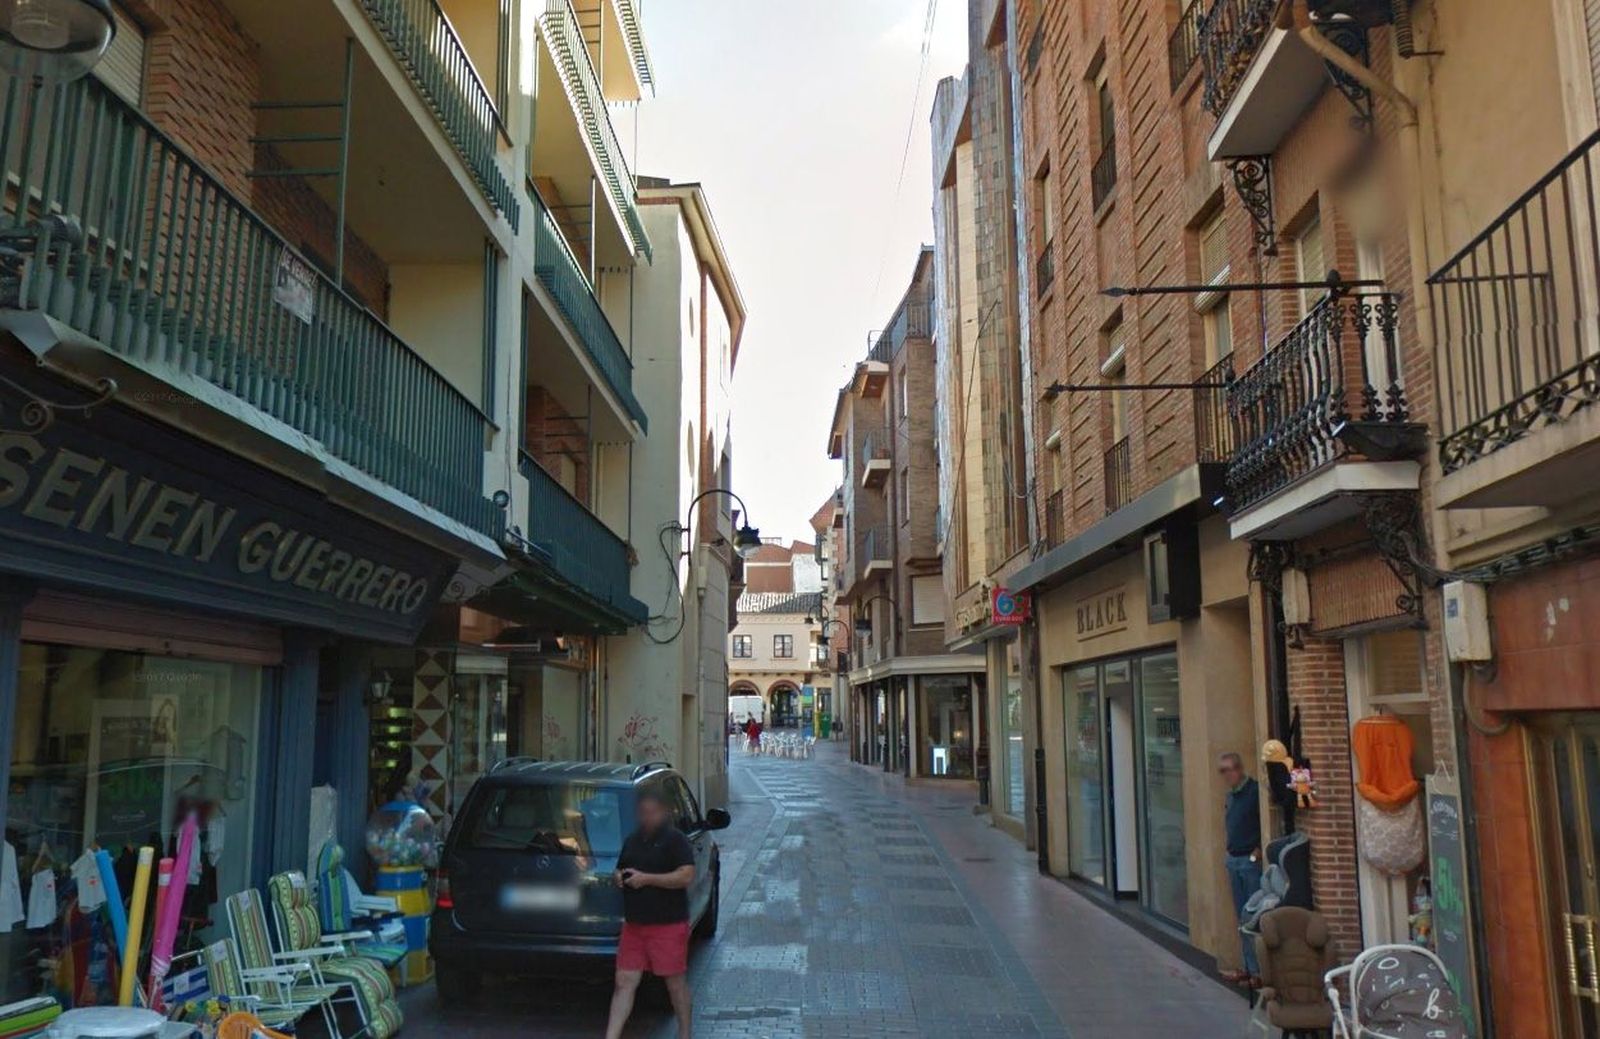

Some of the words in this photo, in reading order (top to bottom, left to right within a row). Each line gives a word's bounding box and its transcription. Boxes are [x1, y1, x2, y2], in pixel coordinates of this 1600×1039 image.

[0, 433, 237, 563] SENEN
[237, 521, 430, 616] GUERRERO
[1077, 592, 1127, 634] BLACK
